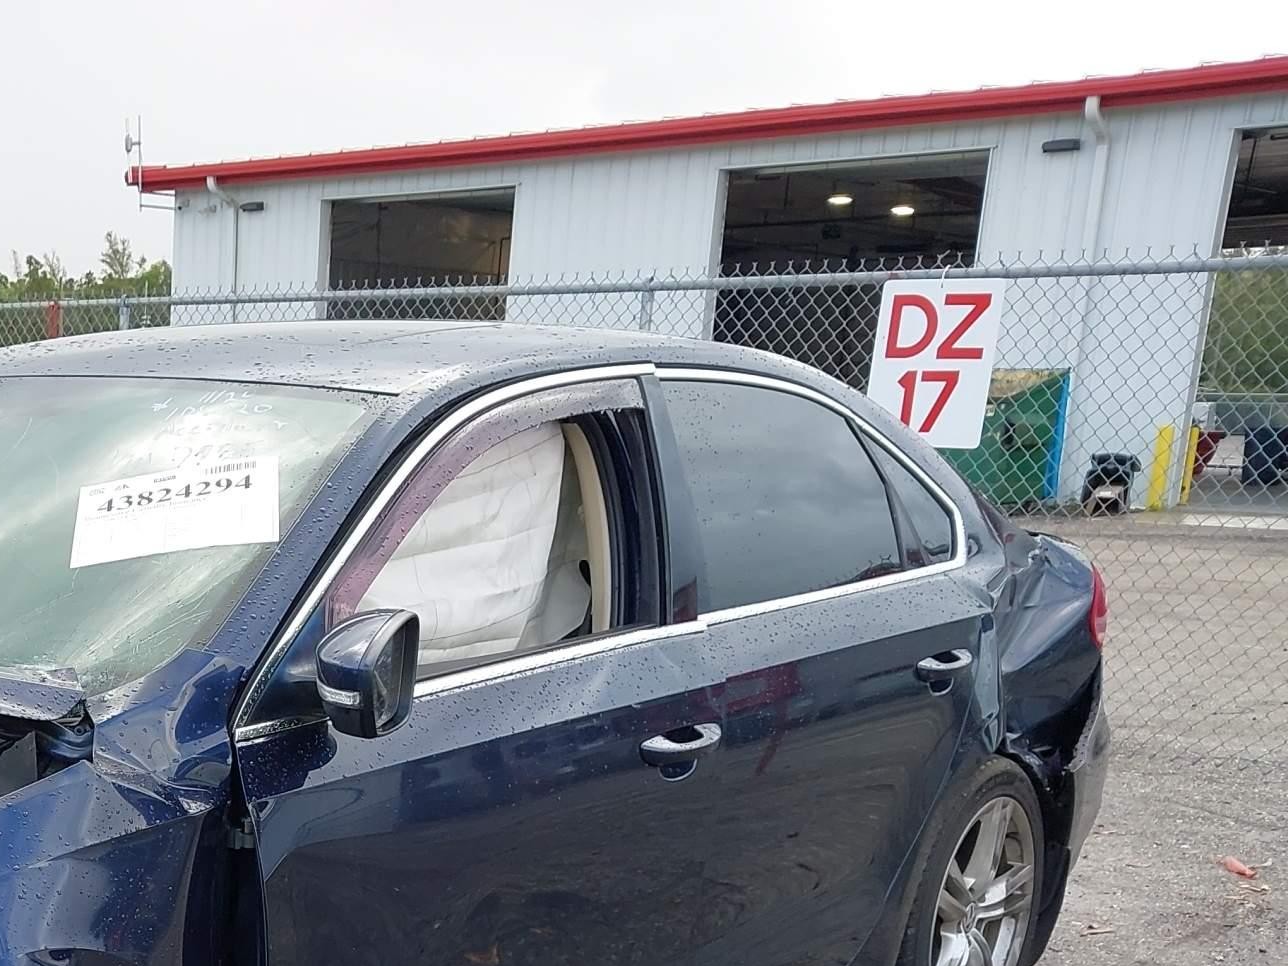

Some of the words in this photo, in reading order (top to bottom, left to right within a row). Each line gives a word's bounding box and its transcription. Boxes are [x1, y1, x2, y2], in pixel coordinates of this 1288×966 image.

[885, 294, 992, 359] DZ
[897, 370, 960, 433] 17
[97, 474, 253, 513] 43824294
